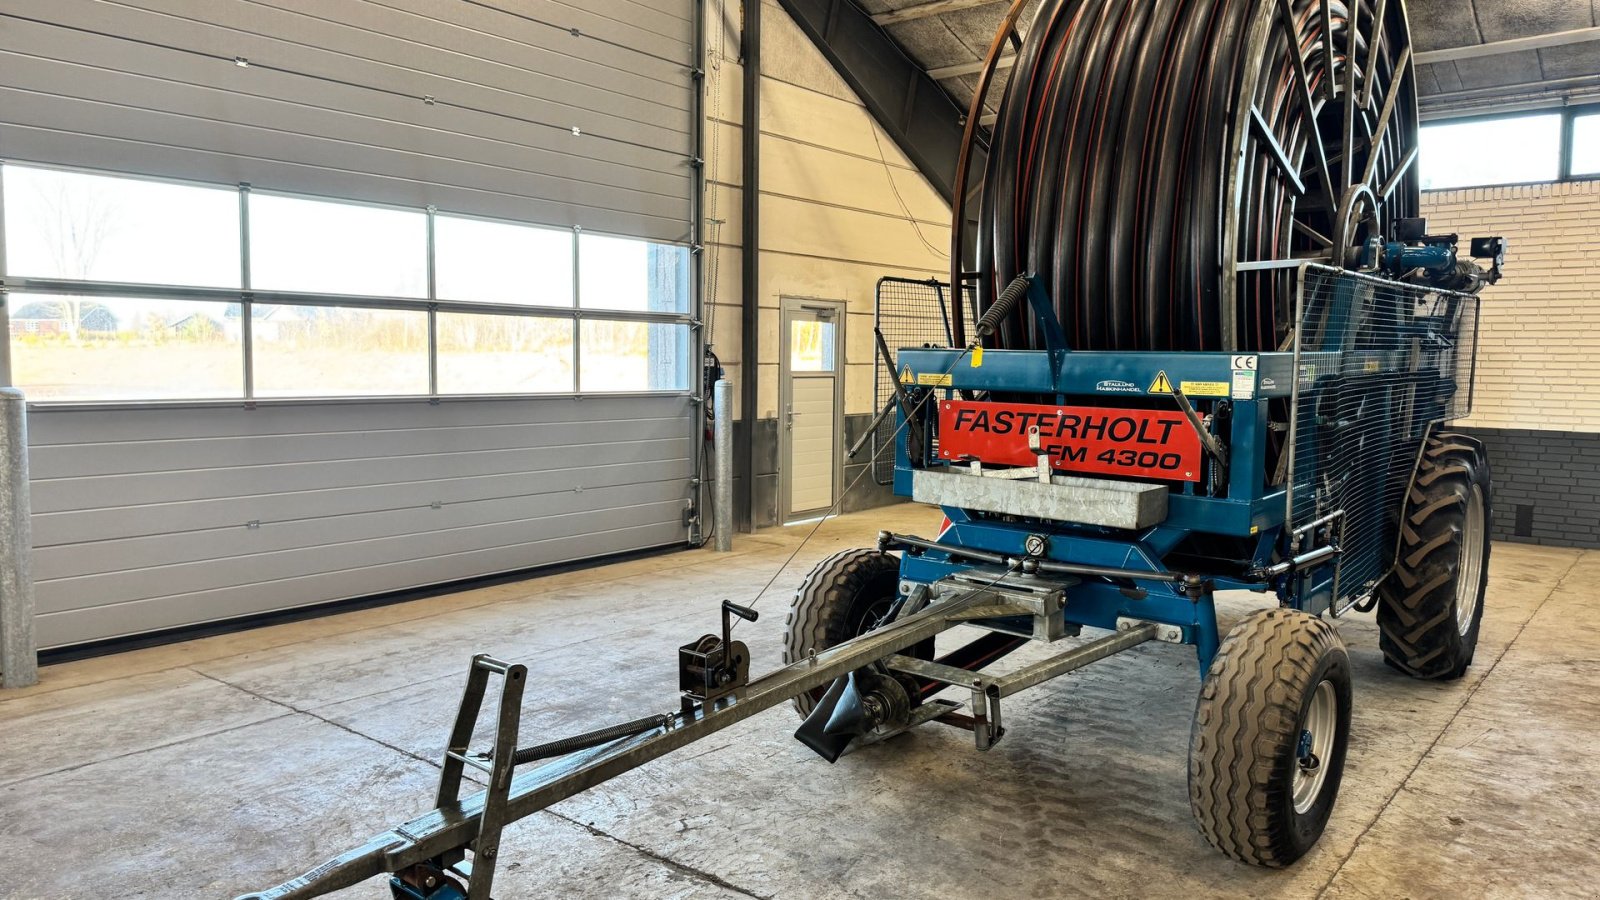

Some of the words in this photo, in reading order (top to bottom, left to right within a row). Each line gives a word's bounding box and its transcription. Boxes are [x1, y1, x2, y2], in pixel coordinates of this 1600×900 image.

[1234, 356, 1254, 369] CE
[954, 409, 1182, 445] FASTERHOLT
[1096, 452, 1181, 470] 4300
